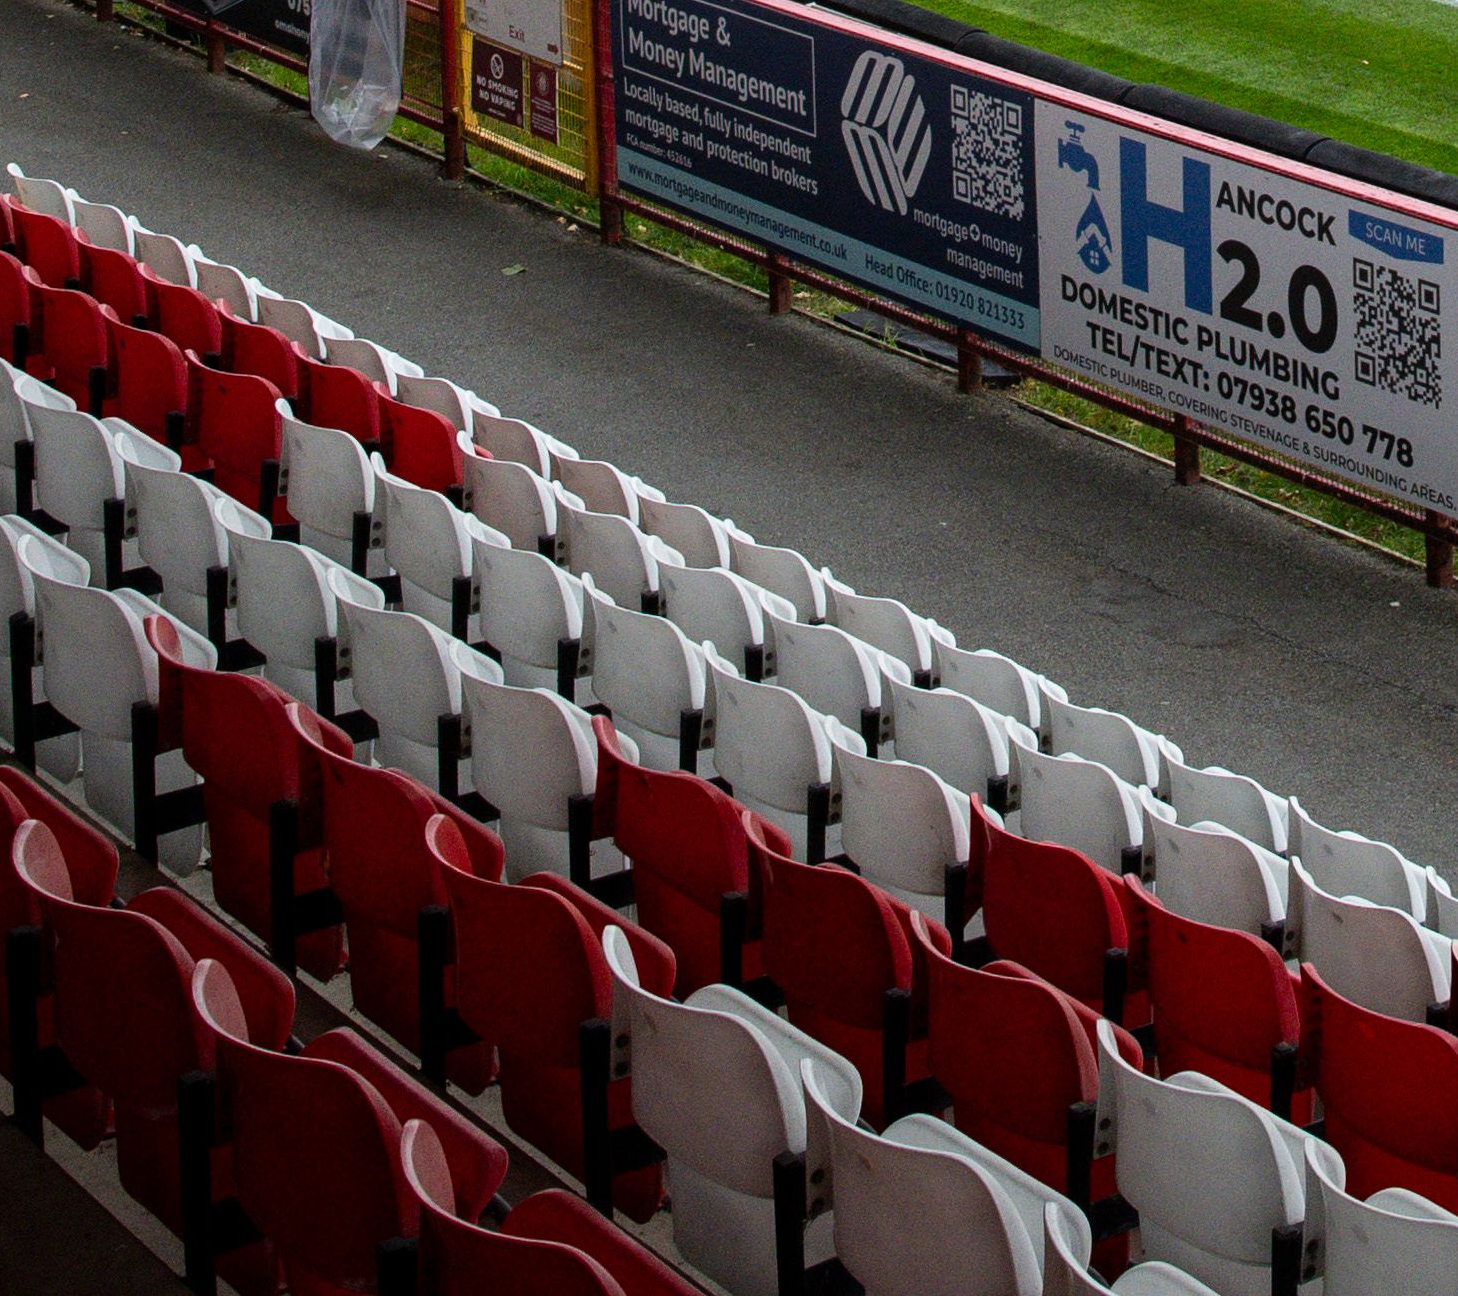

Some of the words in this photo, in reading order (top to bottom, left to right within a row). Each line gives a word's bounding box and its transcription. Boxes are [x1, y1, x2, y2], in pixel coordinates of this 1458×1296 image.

[508, 24, 526, 44] Exit
[628, 27, 684, 78] Money
[688, 46, 808, 116] Management
[716, 17, 732, 47] &
[476, 74, 487, 87] NO
[487, 77, 519, 99] SMOKING
[479, 88, 490, 101] NO
[490, 91, 517, 110] VAPING
[623, 76, 663, 111] Locally
[664, 85, 702, 122] based,
[703, 104, 733, 137] fully
[734, 115, 813, 167] independent
[625, 108, 679, 145] mortgage
[681, 128, 704, 153] and
[706, 136, 769, 178] protection
[770, 157, 819, 196] brokers
[627, 161, 848, 261] www.mortgageandmoneymanagement.co.uk
[913, 207, 969, 244] mortgage
[981, 232, 1023, 265] money
[1118, 135, 1214, 316] H
[1215, 180, 1337, 247] ANCOCK
[1364, 221, 1398, 250] SCAN
[1402, 234, 1427, 258] ME
[864, 252, 892, 277] Head
[895, 265, 933, 297] Office:
[935, 278, 974, 309] 01920
[976, 293, 1026, 330] 821333
[946, 247, 1025, 292] management
[1216, 238, 1340, 355] 2.0
[1060, 273, 1190, 346] DOMESTIC
[1196, 324, 1341, 401] PLUMBING
[1053, 344, 1108, 378] DOMESTIC
[1109, 365, 1167, 404] PLUMBER,
[1168, 389, 1228, 425] COVERING
[1230, 413, 1300, 452] STEVENAGE
[1302, 440, 1311, 456] &
[1312, 444, 1408, 493] SURROUNDING
[1410, 480, 1458, 512] AREAS.
[1085, 321, 1211, 393] TEL/TEXT:
[1216, 370, 1298, 425] 07938
[1304, 403, 1355, 446] 650
[1361, 423, 1414, 468] 778
